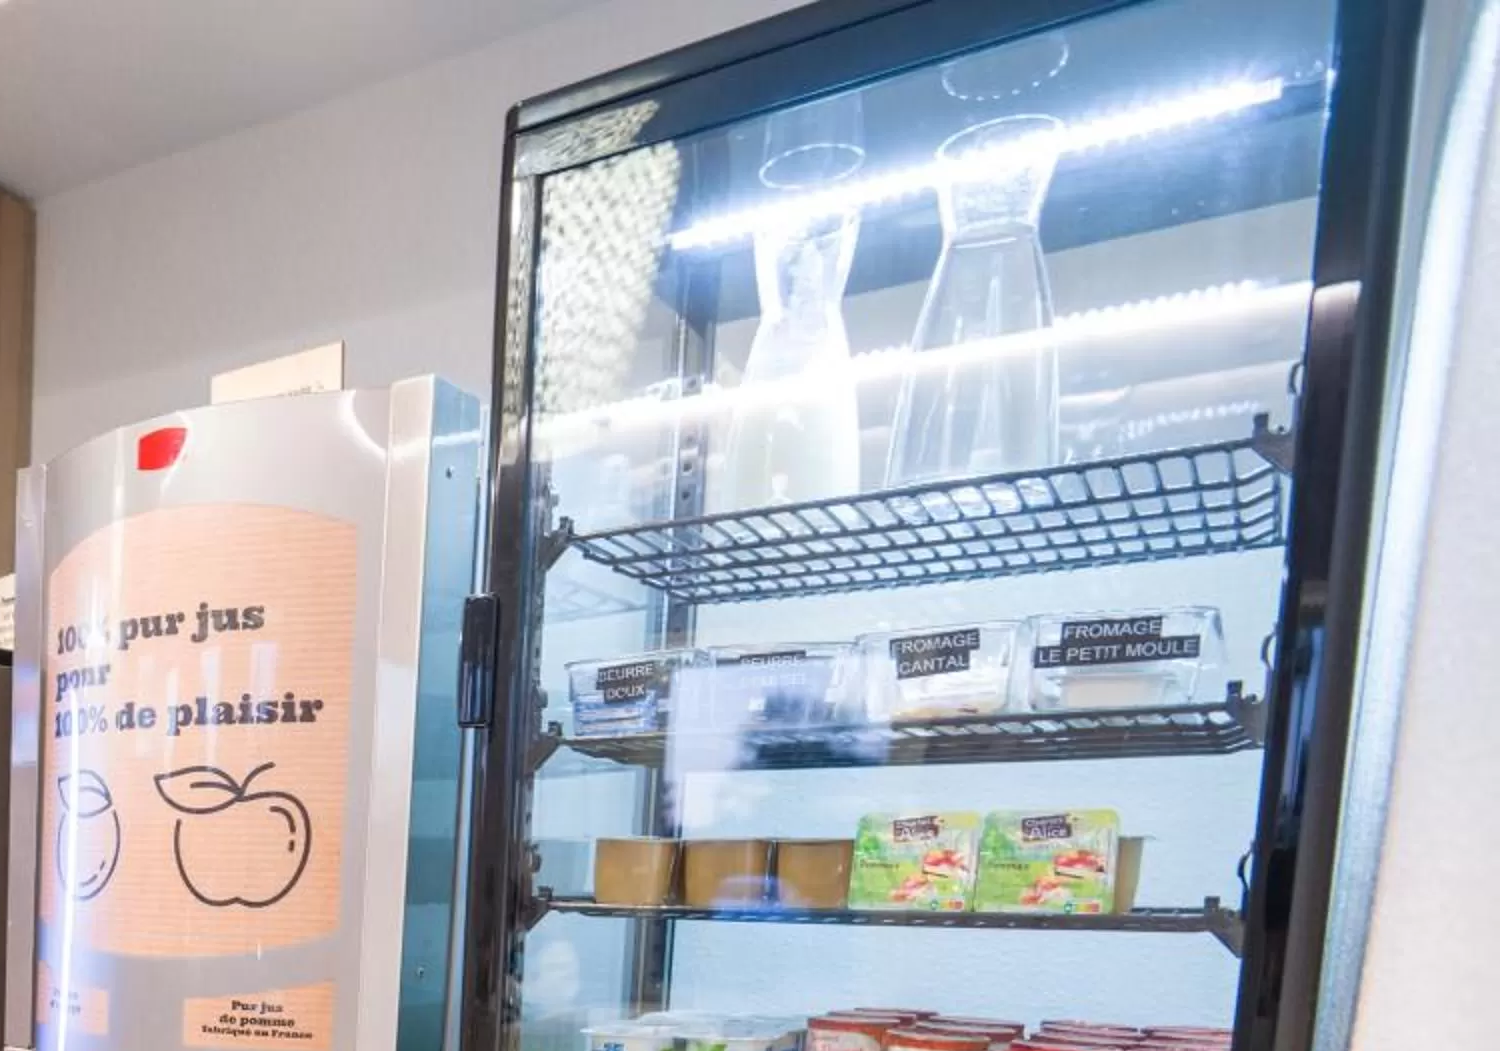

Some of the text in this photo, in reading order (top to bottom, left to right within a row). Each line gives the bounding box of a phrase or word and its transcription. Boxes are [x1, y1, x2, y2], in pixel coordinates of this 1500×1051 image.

[118, 613, 185, 650] pur
[190, 602, 266, 643] jus
[1062, 619, 1162, 640] FROMAGE
[891, 632, 979, 657] FROMAGE
[1038, 639, 1198, 665] LE PETIT MOULE
[899, 657, 967, 675] CANTAL
[55, 664, 111, 702] pour
[115, 702, 156, 732] de
[167, 692, 324, 737] plaisir
[231, 1000, 284, 1014] Pur jus
[219, 1013, 296, 1028] de pomme
